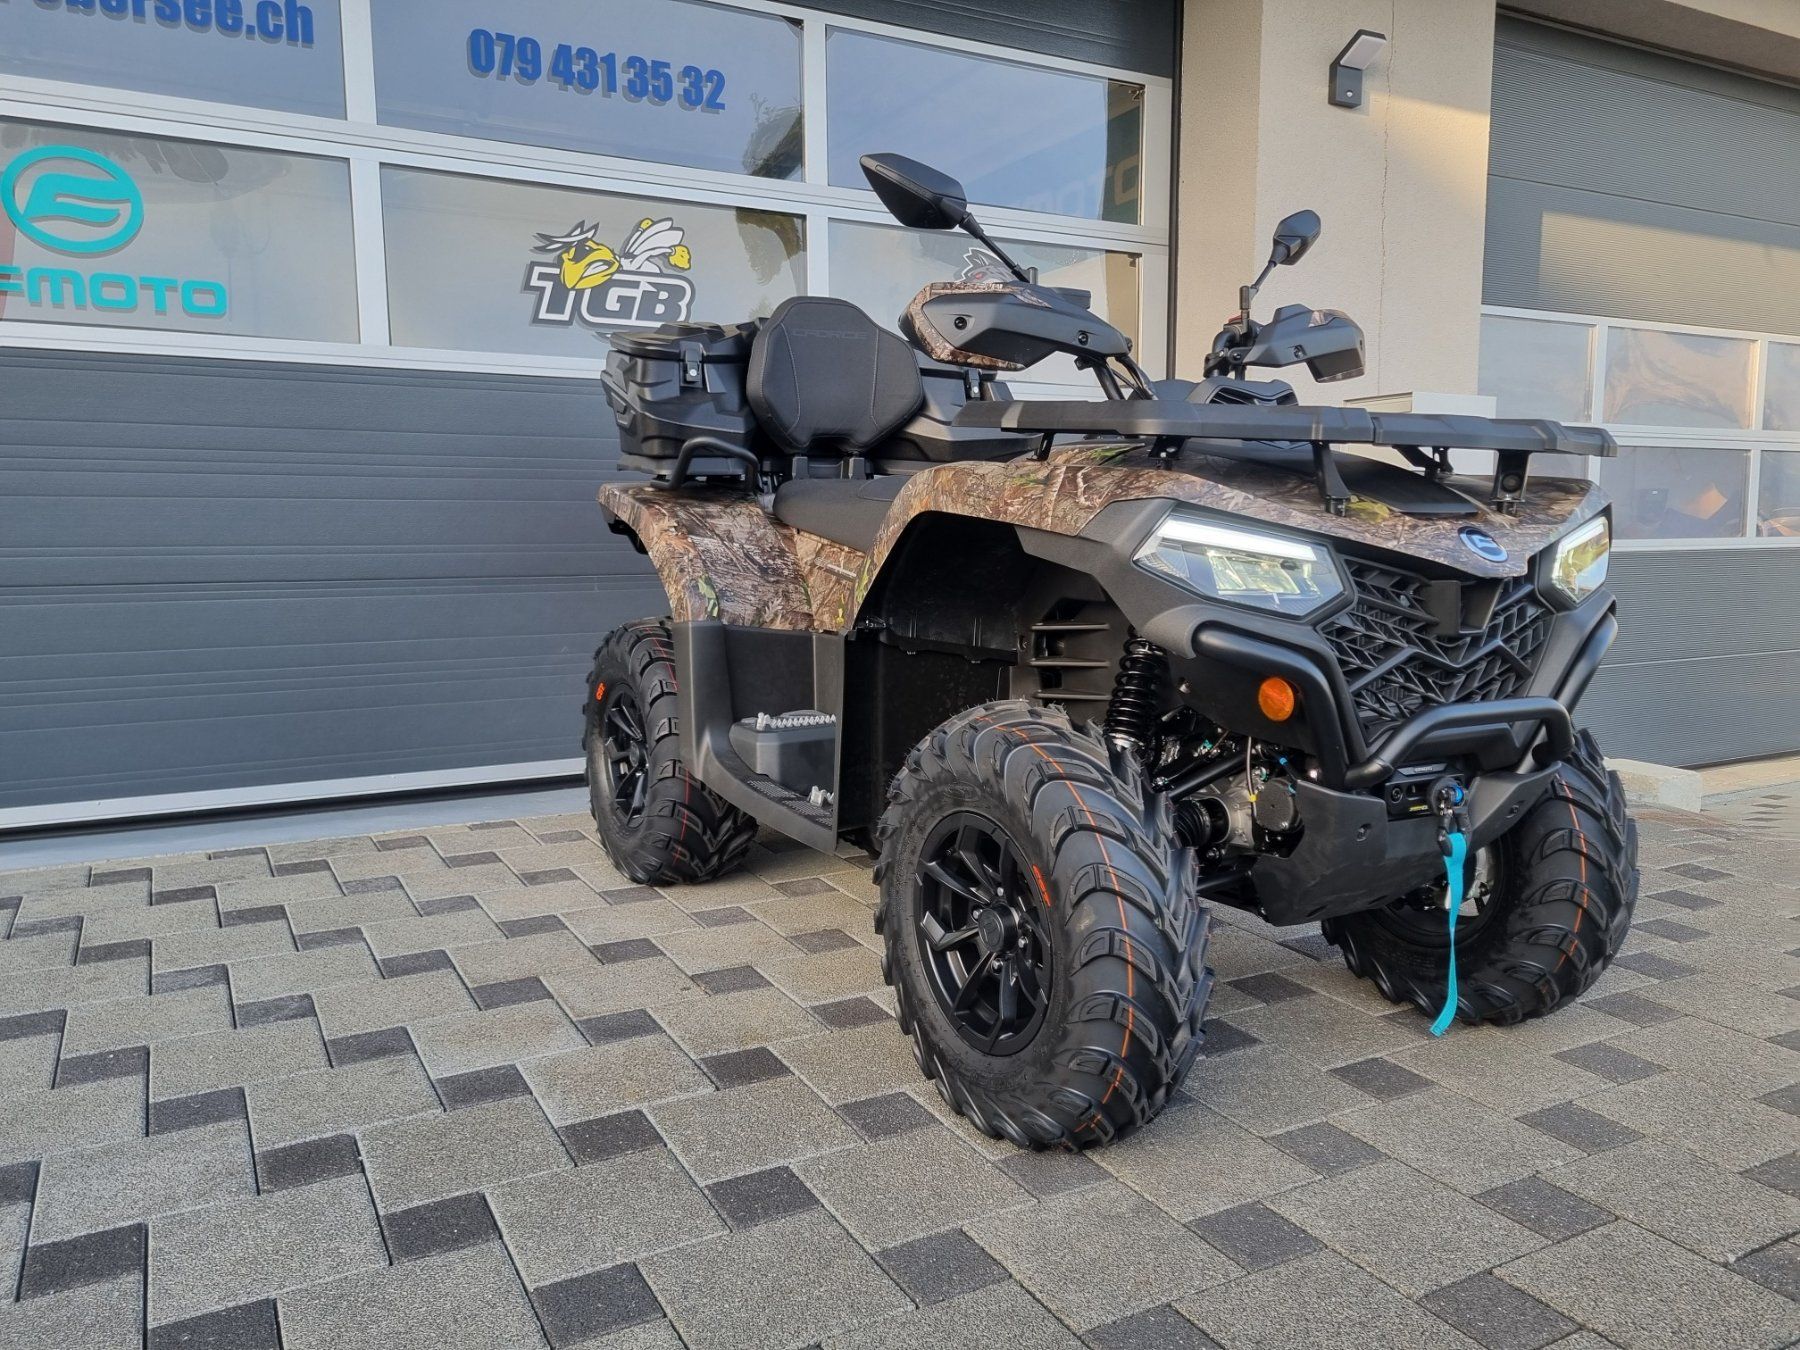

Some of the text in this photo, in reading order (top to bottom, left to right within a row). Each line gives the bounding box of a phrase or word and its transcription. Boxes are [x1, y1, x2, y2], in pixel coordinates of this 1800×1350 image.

[469, 28, 726, 110] 079 431 35 32
[525, 261, 696, 328] TGB
